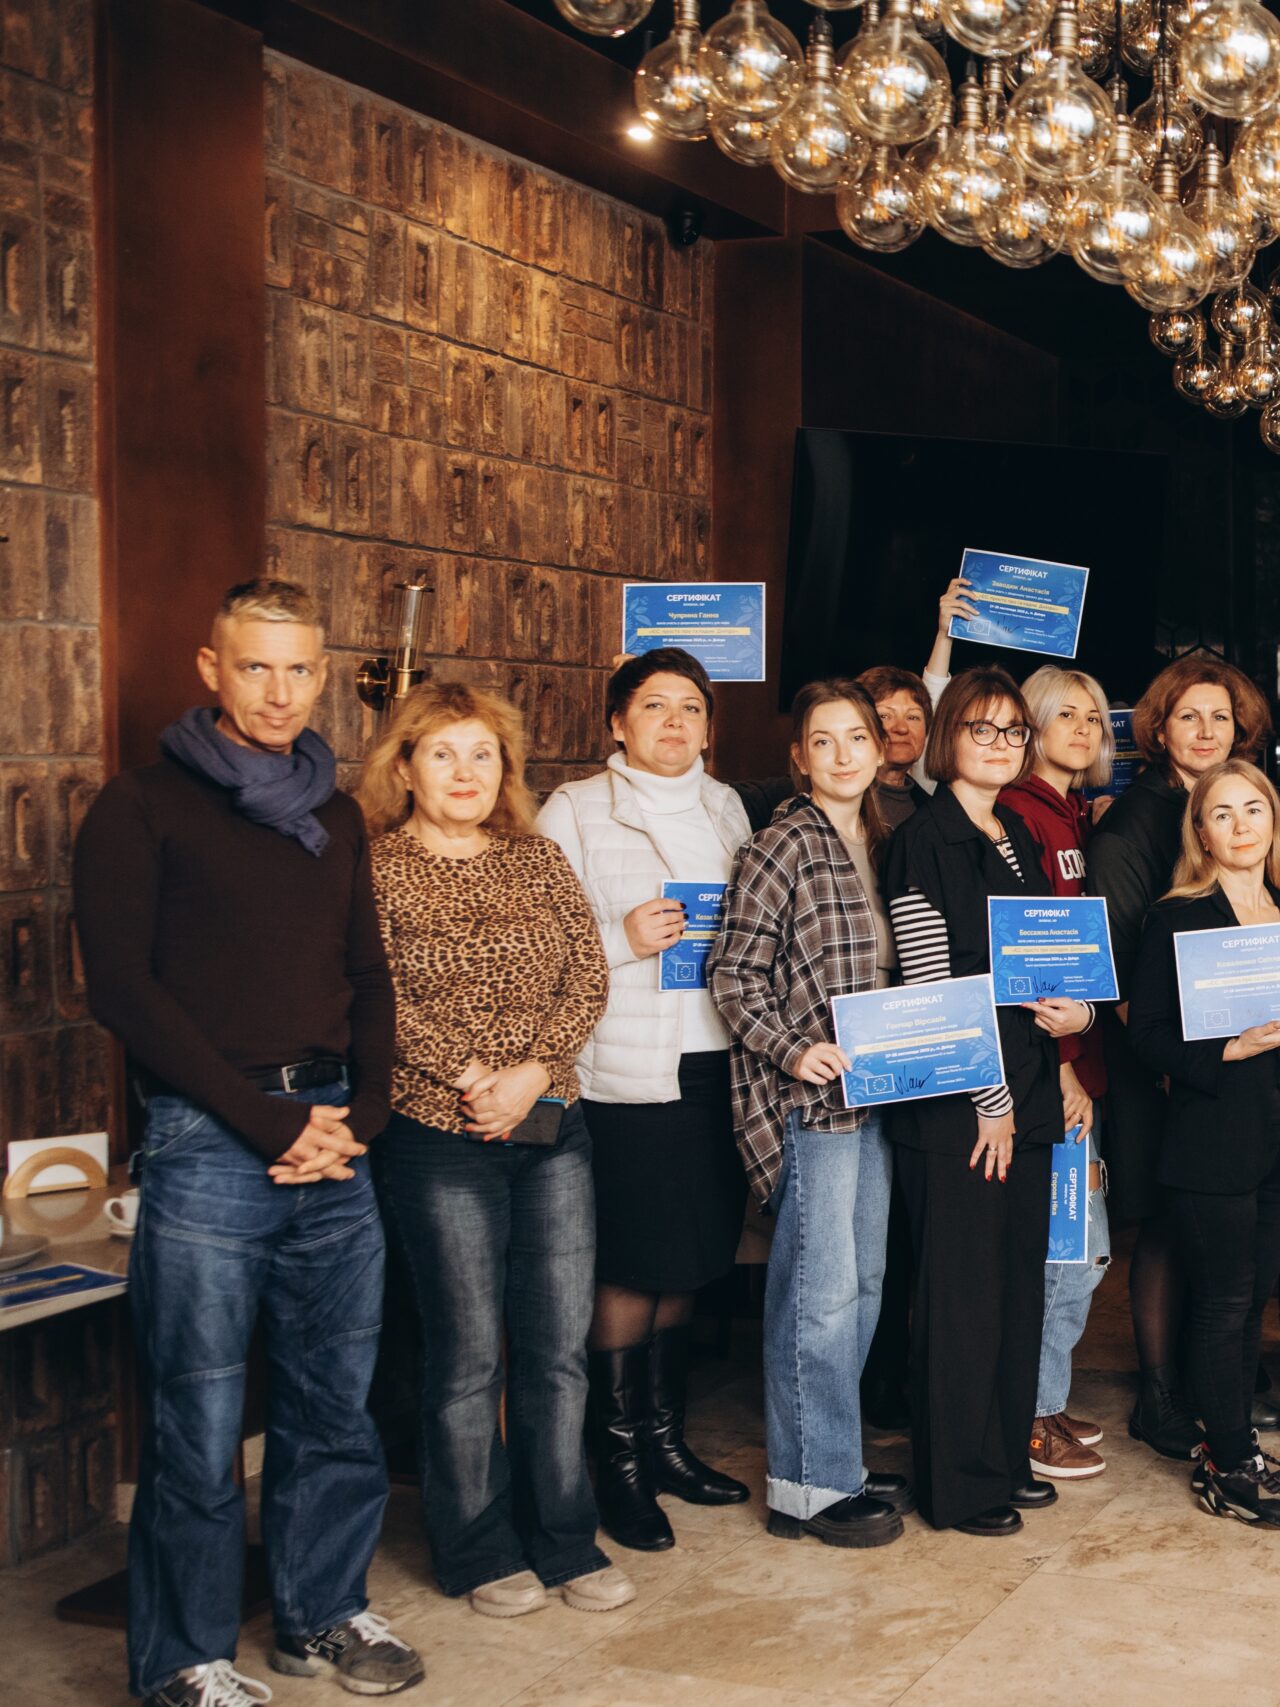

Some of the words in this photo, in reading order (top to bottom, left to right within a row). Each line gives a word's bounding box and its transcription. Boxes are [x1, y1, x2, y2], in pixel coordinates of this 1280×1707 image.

[999, 564, 1048, 578] СЕРТИФІКАТ
[698, 894, 722, 902] СЕРТИ
[1024, 909, 1070, 918] СЕРТИФІКАТ
[1222, 935, 1280, 948] СЕРТИФІКАТ
[882, 994, 944, 1010] СЕРТИФІКАТ
[1069, 1167, 1078, 1221] СЕРТИФІКАТ
